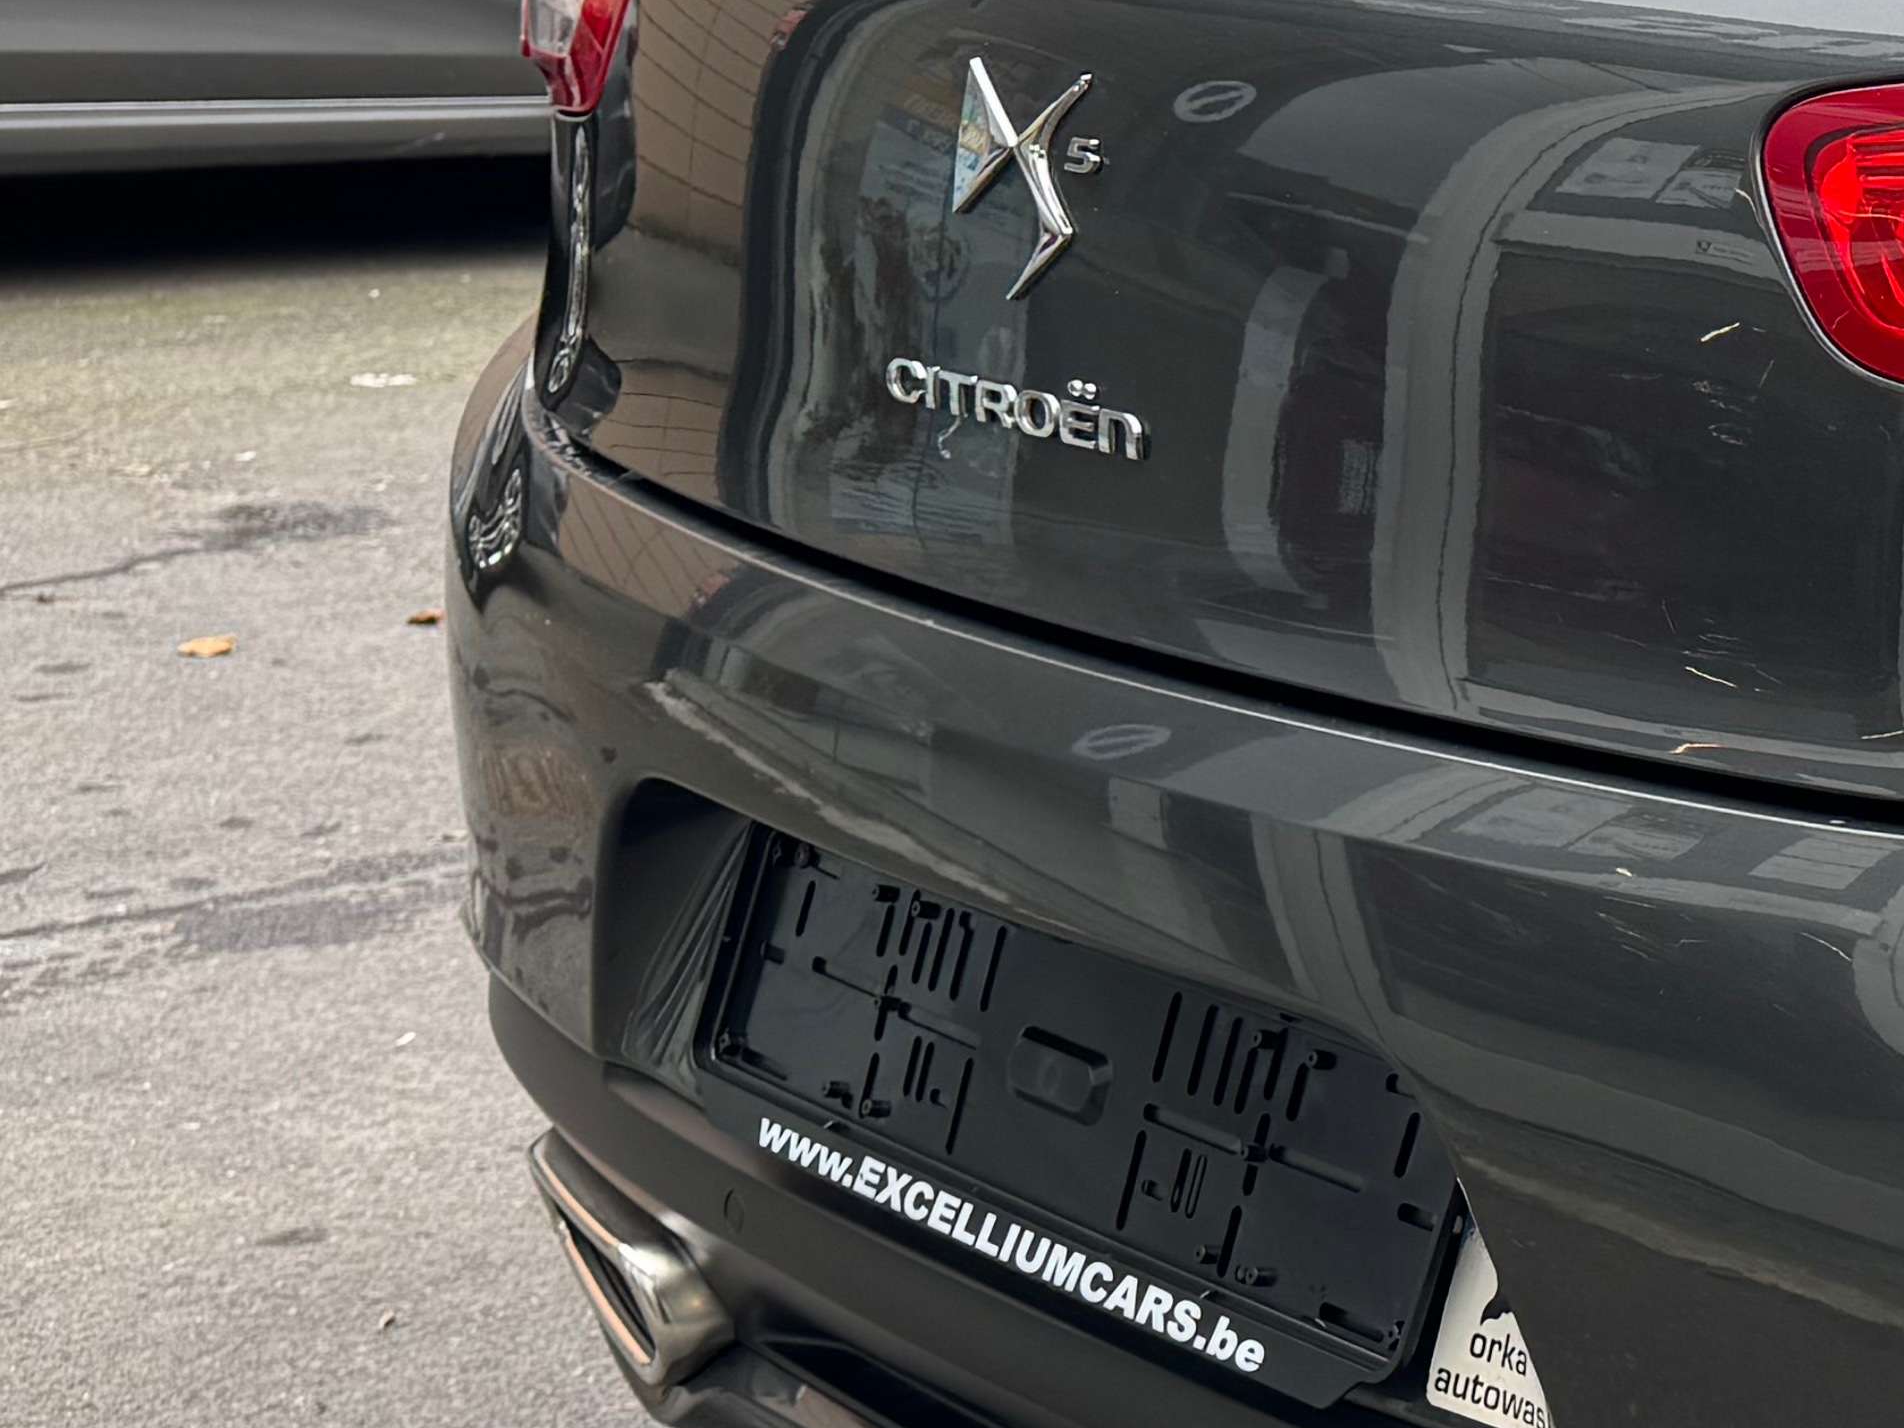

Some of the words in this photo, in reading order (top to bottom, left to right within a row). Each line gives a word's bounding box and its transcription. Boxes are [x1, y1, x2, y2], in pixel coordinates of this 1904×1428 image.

[1063, 136, 1104, 174] 5
[758, 1117, 1265, 1373] www.EXCELLIUMCARS.be
[1469, 1332, 1527, 1378] orka
